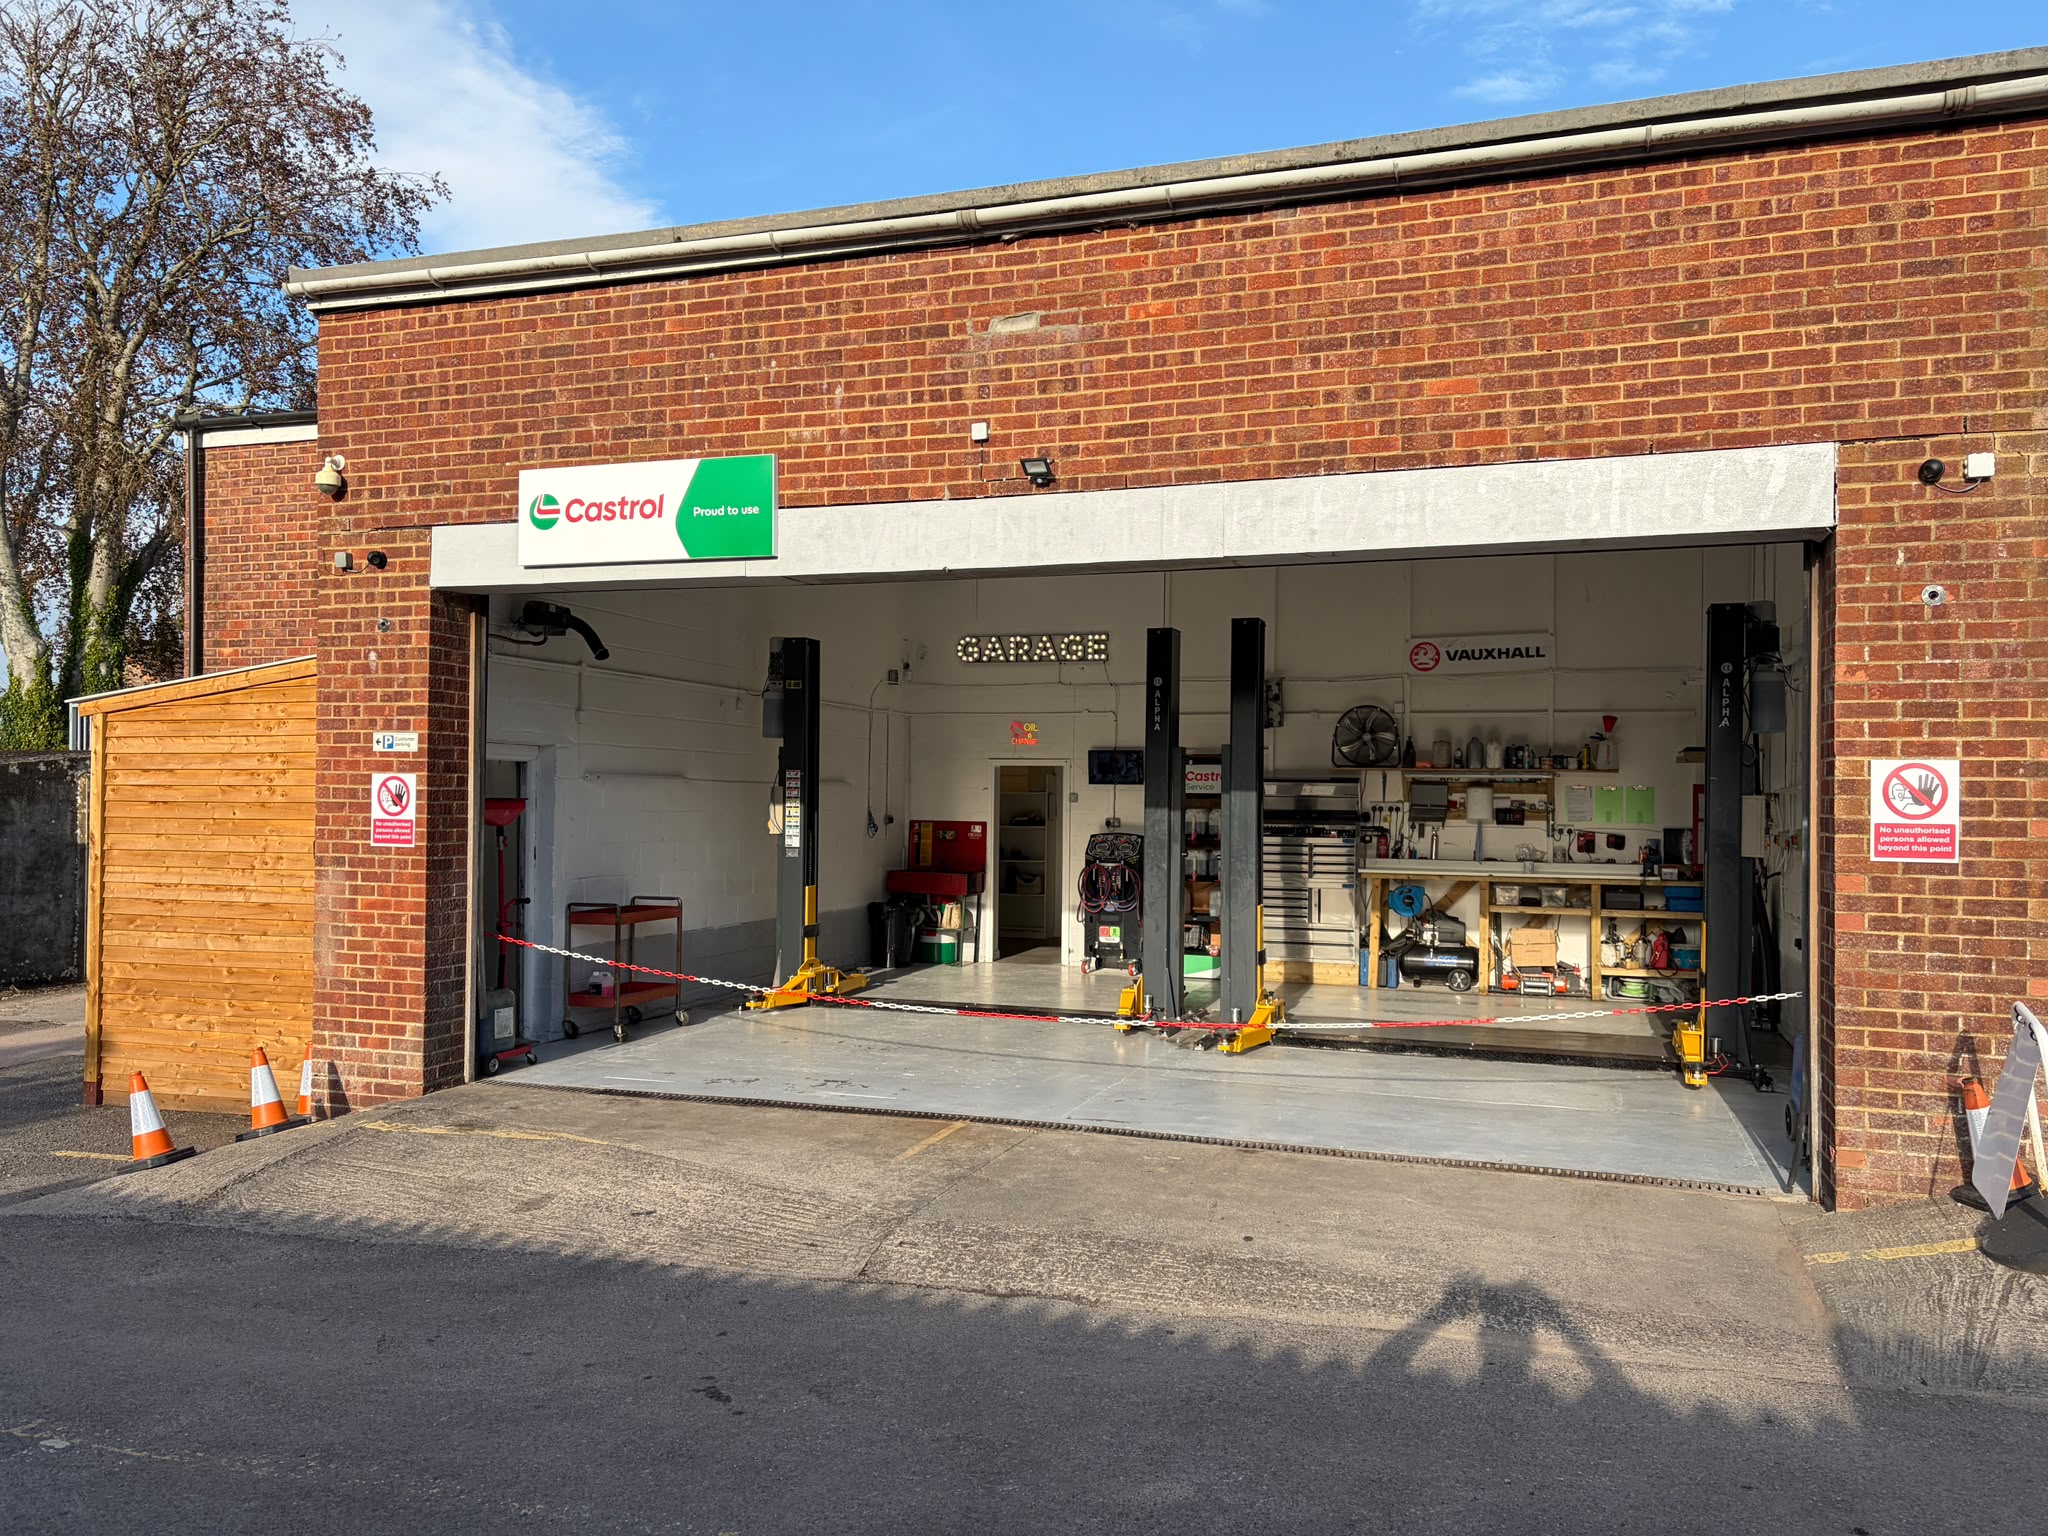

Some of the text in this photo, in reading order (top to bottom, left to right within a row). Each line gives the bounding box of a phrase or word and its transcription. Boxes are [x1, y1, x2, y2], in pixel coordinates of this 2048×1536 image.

[565, 494, 664, 522] Castrol
[693, 505, 760, 517] Proud to use
[957, 633, 1109, 663] GARAGE
[1445, 646, 1546, 662] VAUXHALL
[1721, 678, 1730, 727] ALPHA
[1023, 722, 1039, 732] OIL
[384, 735, 393, 749] P
[1011, 737, 1039, 745] CHANGE
[1185, 770, 1222, 782] Castr
[1893, 826, 1951, 834] unauthorised
[1877, 844, 1952, 853] beyond this point
